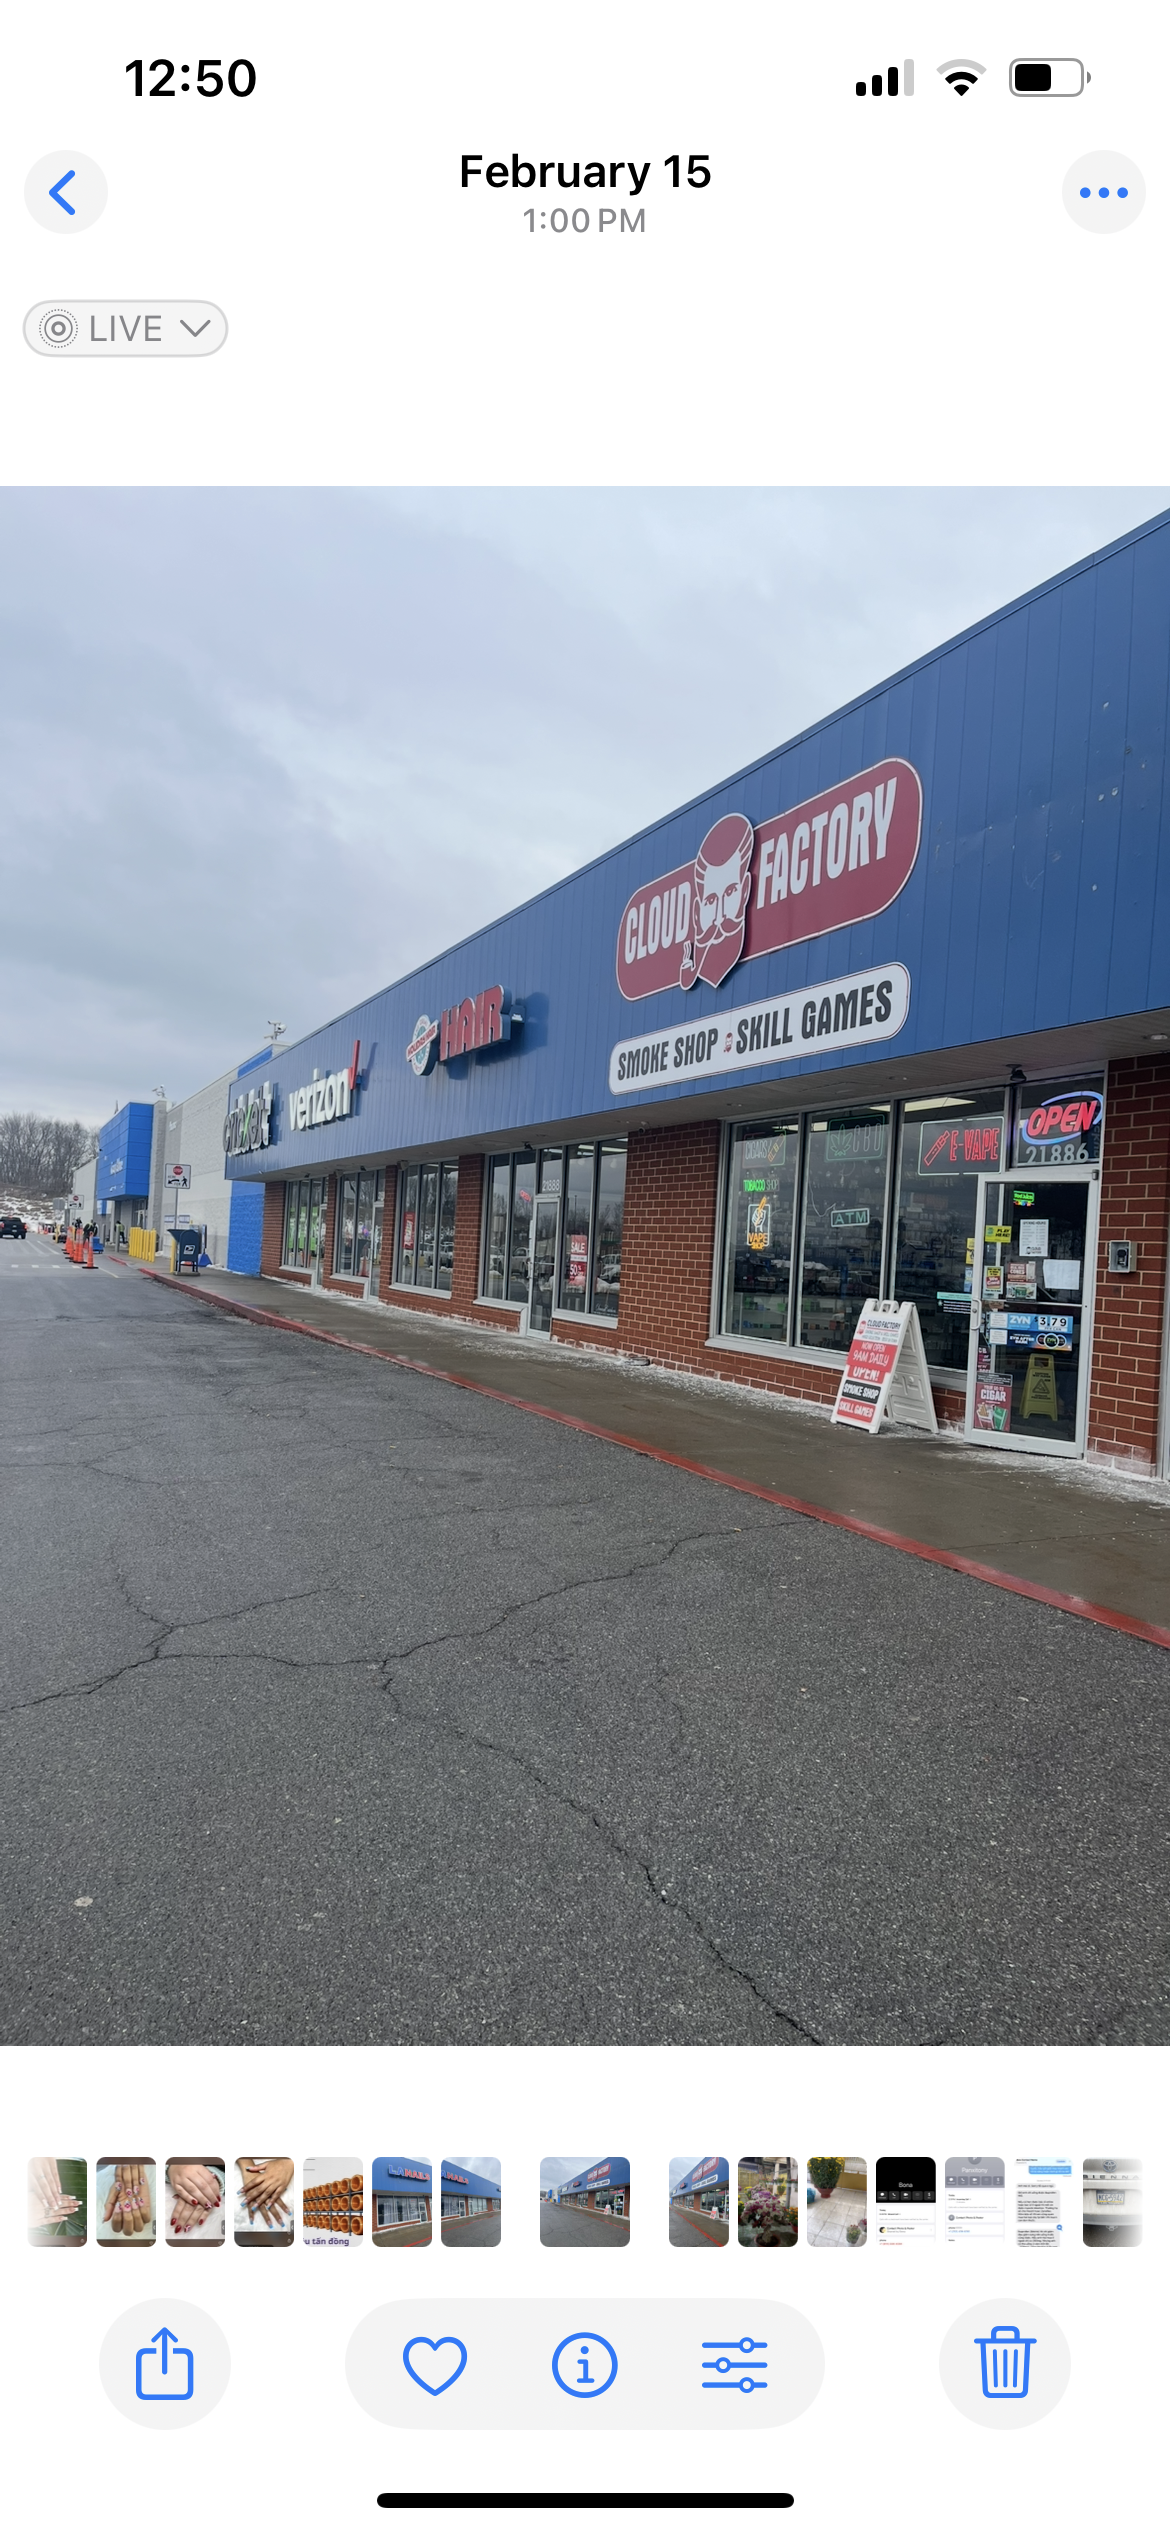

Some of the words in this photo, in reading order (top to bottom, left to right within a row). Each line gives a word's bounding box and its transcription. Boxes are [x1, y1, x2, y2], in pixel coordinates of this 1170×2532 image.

[624, 881, 692, 965] CLOUD
[756, 777, 897, 909] FACTORY
[440, 984, 505, 1061] HAIR
[618, 1041, 669, 1081] SMOKE
[674, 1028, 718, 1068] SHOP
[736, 1007, 793, 1054] SKILL
[801, 980, 893, 1039] GAMES
[289, 1068, 351, 1131] verizon
[223, 1081, 272, 1157] cricket
[1027, 1100, 1098, 1137] OPEN
[745, 1140, 768, 1160] CIGARS
[949, 1128, 1000, 1162] E-VAPE
[1026, 1142, 1089, 1164] 21886
[542, 1179, 560, 1192] 21888
[743, 1179, 765, 1192] TOBACCO
[766, 1179, 778, 1191] SHOP
[834, 1210, 867, 1225] ATM
[748, 1232, 768, 1245] VAPE
[571, 1242, 585, 1254] SALE
[867, 1319, 881, 1327] CLOUD
[881, 1321, 901, 1330] FACTORY
[1010, 1315, 1030, 1324] ZYN
[872, 1343, 886, 1353] OPEN
[853, 1350, 869, 1362] 9AM
[868, 1352, 890, 1367] DAILY
[843, 1383, 863, 1396] SMOKE
[862, 1387, 879, 1399] SHOP
[980, 1388, 1006, 1402] CIGAR
[839, 1401, 854, 1414] SKILL
[854, 1404, 873, 1418] GAMES
[404, 2167, 430, 2181] NAILS
